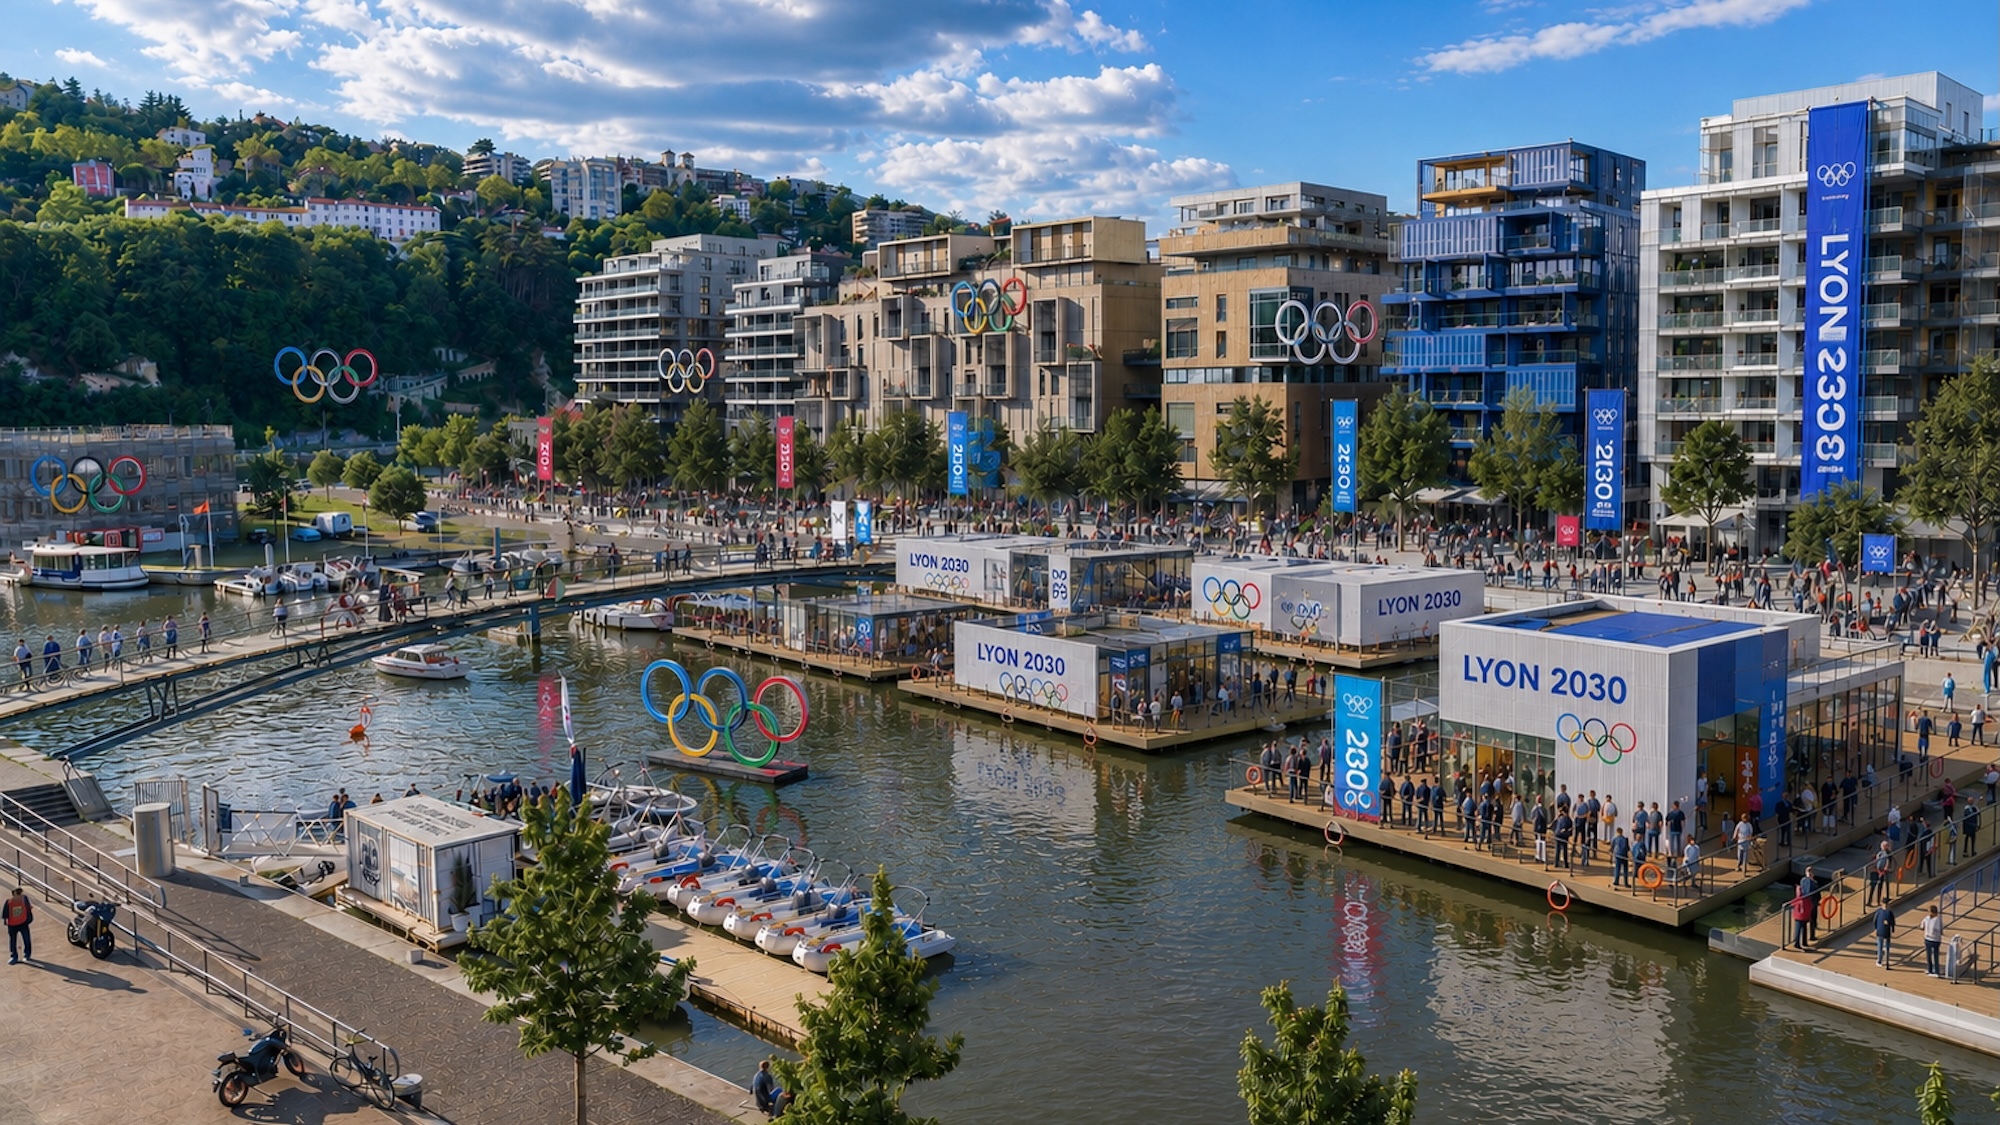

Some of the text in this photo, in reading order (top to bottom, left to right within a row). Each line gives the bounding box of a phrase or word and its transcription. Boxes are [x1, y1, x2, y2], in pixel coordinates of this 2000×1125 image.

[1818, 233, 1849, 342] LYON
[909, 552, 969, 573] LYON 2030
[1378, 590, 1461, 616] LYON 2030
[978, 643, 1065, 676] LYON 2030
[1463, 654, 1628, 705] LYON 2030
